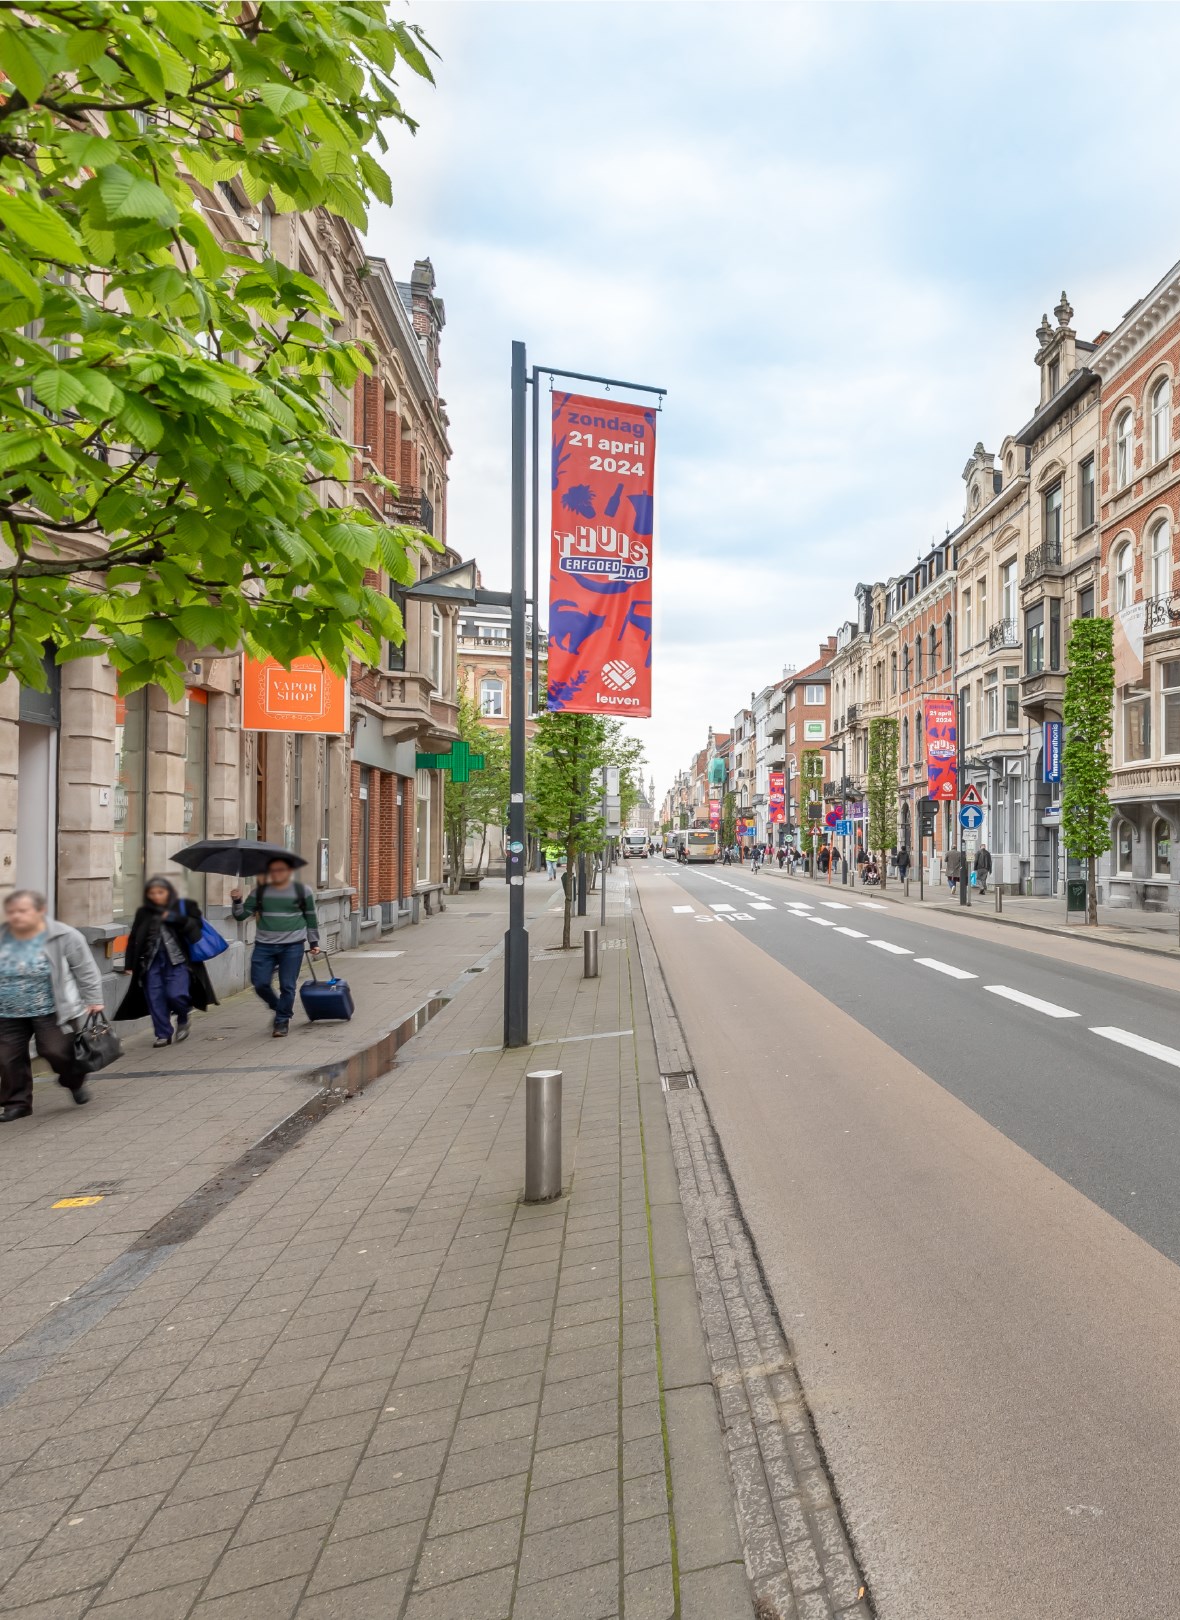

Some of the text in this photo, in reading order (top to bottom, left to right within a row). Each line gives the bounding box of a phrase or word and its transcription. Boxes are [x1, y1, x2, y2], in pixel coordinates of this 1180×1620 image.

[567, 412, 645, 438] zondag
[568, 430, 645, 456] 21 april
[589, 455, 645, 476] 2024
[553, 525, 649, 566] THUIS
[273, 681, 317, 691] VAPOR
[277, 692, 313, 701] SHOP
[596, 692, 640, 706] leuven
[1051, 723, 1059, 777] immoanthonis
[693, 912, 757, 923] BUS
